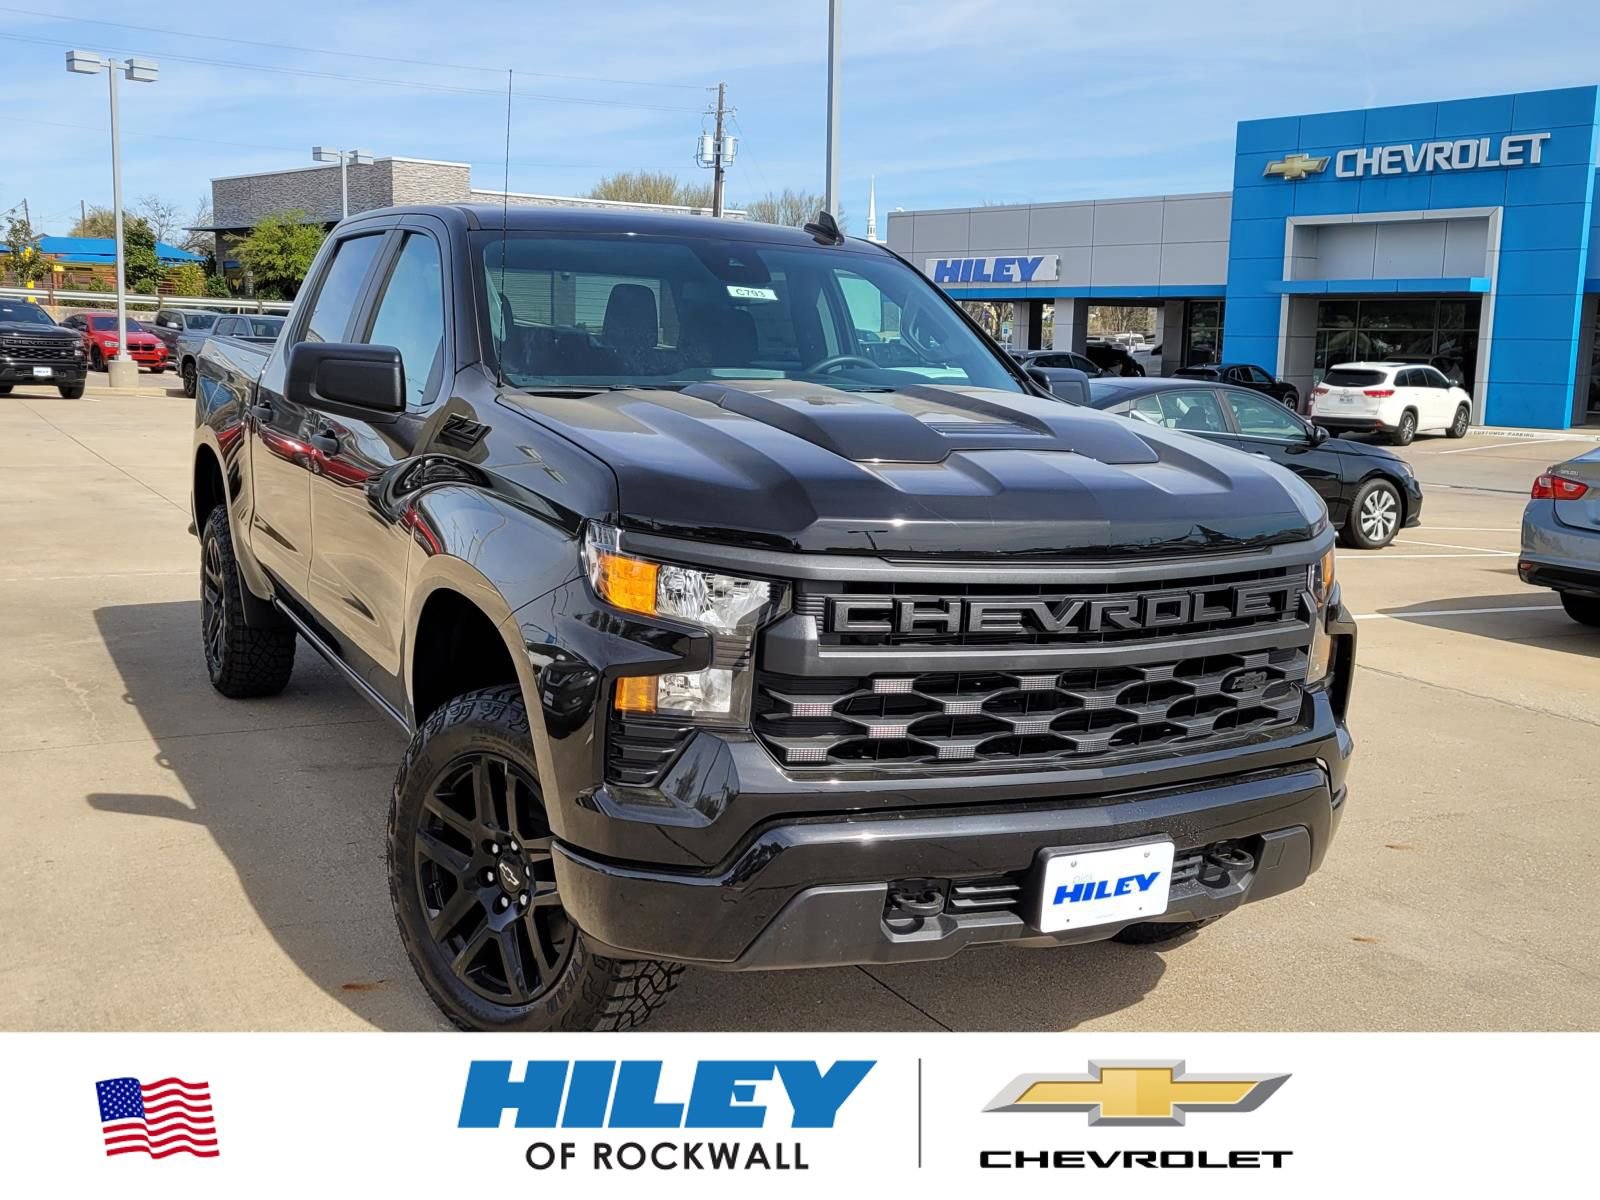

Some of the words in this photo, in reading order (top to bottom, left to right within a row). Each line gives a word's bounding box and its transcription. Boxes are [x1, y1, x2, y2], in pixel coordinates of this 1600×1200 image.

[1335, 132, 1551, 178] CHEVROLET
[934, 257, 1044, 283] HILEY
[828, 584, 1299, 634] CHEVROLET
[1053, 871, 1161, 905] HILEY
